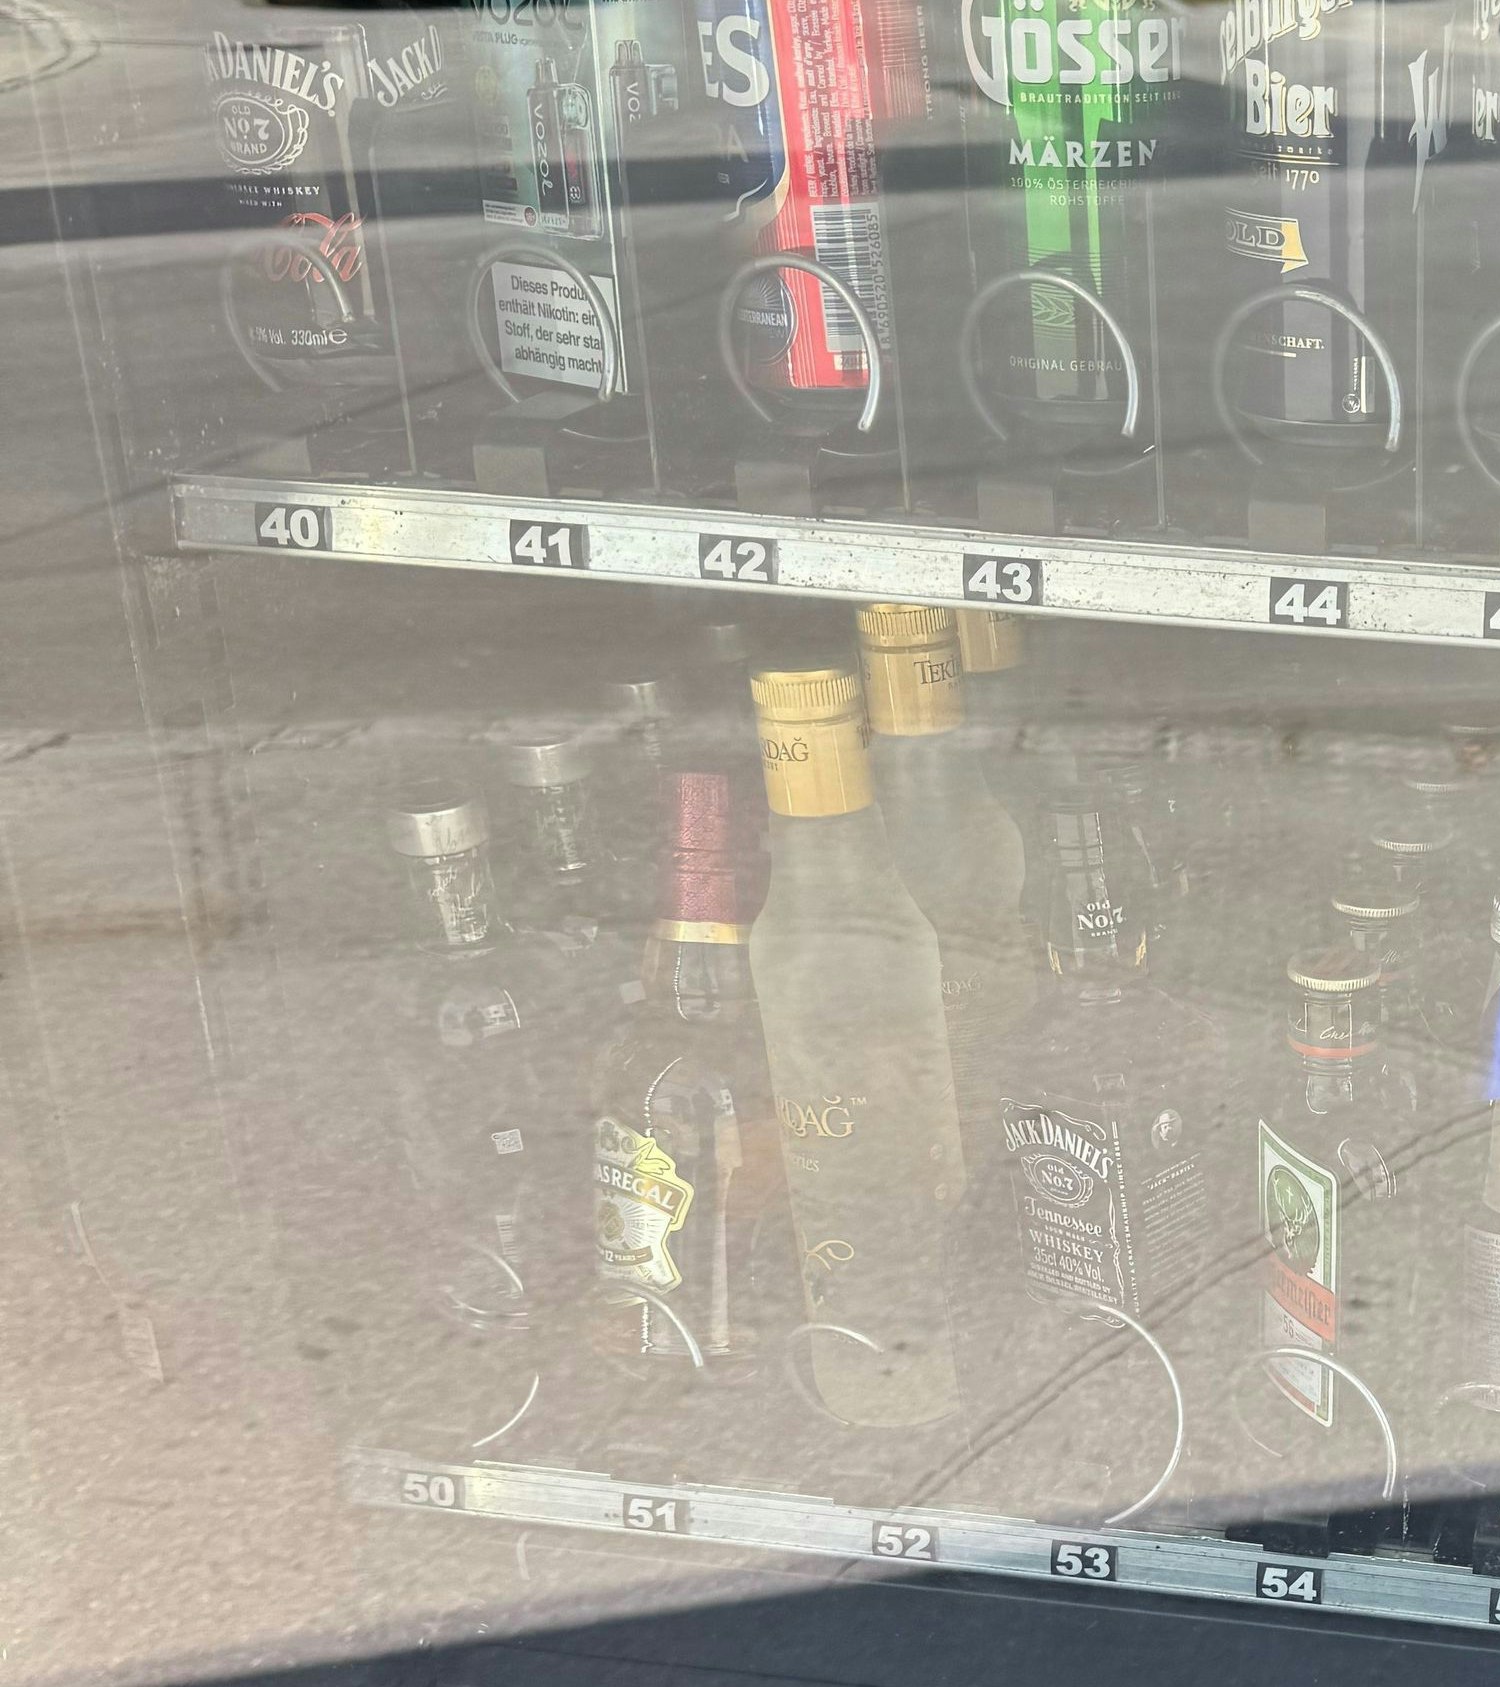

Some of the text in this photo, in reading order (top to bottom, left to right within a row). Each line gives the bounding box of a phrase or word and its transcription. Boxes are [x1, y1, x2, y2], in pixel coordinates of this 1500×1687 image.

[1020, 92, 1129, 104] BRAUTRADITION
[1245, 58, 1338, 140] Bier
[1009, 135, 1159, 168] MÄRZEN
[263, 186, 320, 196] WHISKEY
[1011, 177, 1043, 190] 100%
[1285, 169, 1320, 191] 1770
[511, 275, 548, 296] Dieses
[499, 299, 536, 317] enthält
[538, 302, 579, 324] Nikotin:
[505, 320, 533, 342] Stoff,
[535, 326, 553, 342] der
[556, 331, 580, 347] sehr
[515, 346, 565, 371] abhängig
[1009, 356, 1065, 372] ORIGINAL
[259, 506, 320, 549] 40
[515, 525, 573, 567] 41
[703, 540, 770, 581] 42
[967, 560, 1034, 603] 43
[1273, 583, 1342, 625] 44
[1002, 1113, 1114, 1180] JACK DANIEL'S
[1024, 1196, 1103, 1237] Tennessee
[604, 1250, 614, 1262] 12
[1029, 1228, 1104, 1263] WHISKEY
[1034, 1246, 1105, 1283] 35cl 40% Vol.
[404, 1475, 456, 1507] 50
[627, 1498, 678, 1531] 51
[876, 1527, 933, 1559] 52
[1056, 1543, 1111, 1579] 53
[1262, 1567, 1318, 1602] 54
